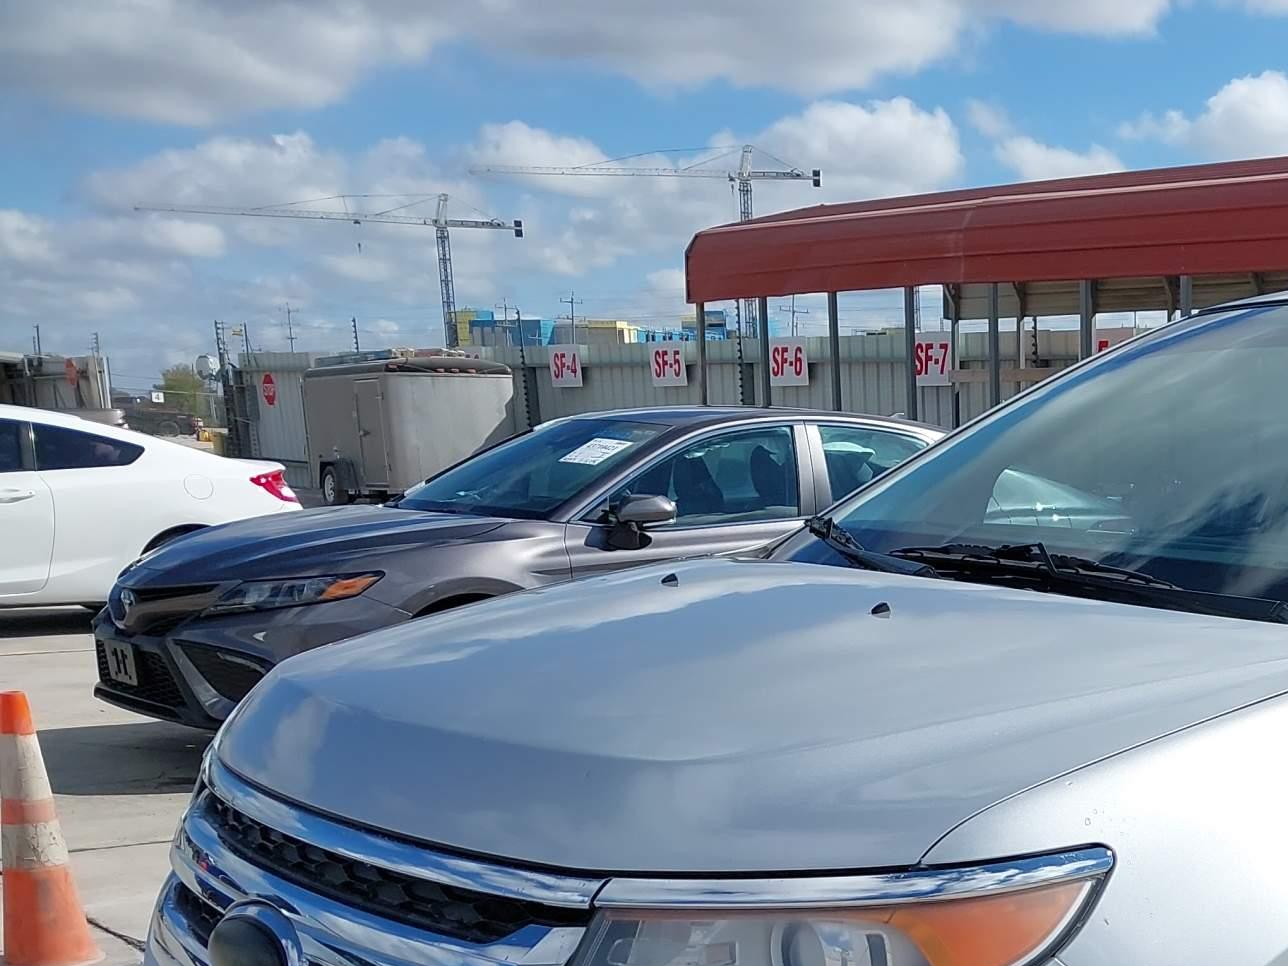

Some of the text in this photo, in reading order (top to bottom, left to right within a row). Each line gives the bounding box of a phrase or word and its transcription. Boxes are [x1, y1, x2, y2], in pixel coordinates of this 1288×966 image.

[553, 352, 578, 379] SF-4
[654, 349, 681, 378] SF-5
[771, 346, 803, 377] SF-6
[915, 342, 949, 376] SF-7
